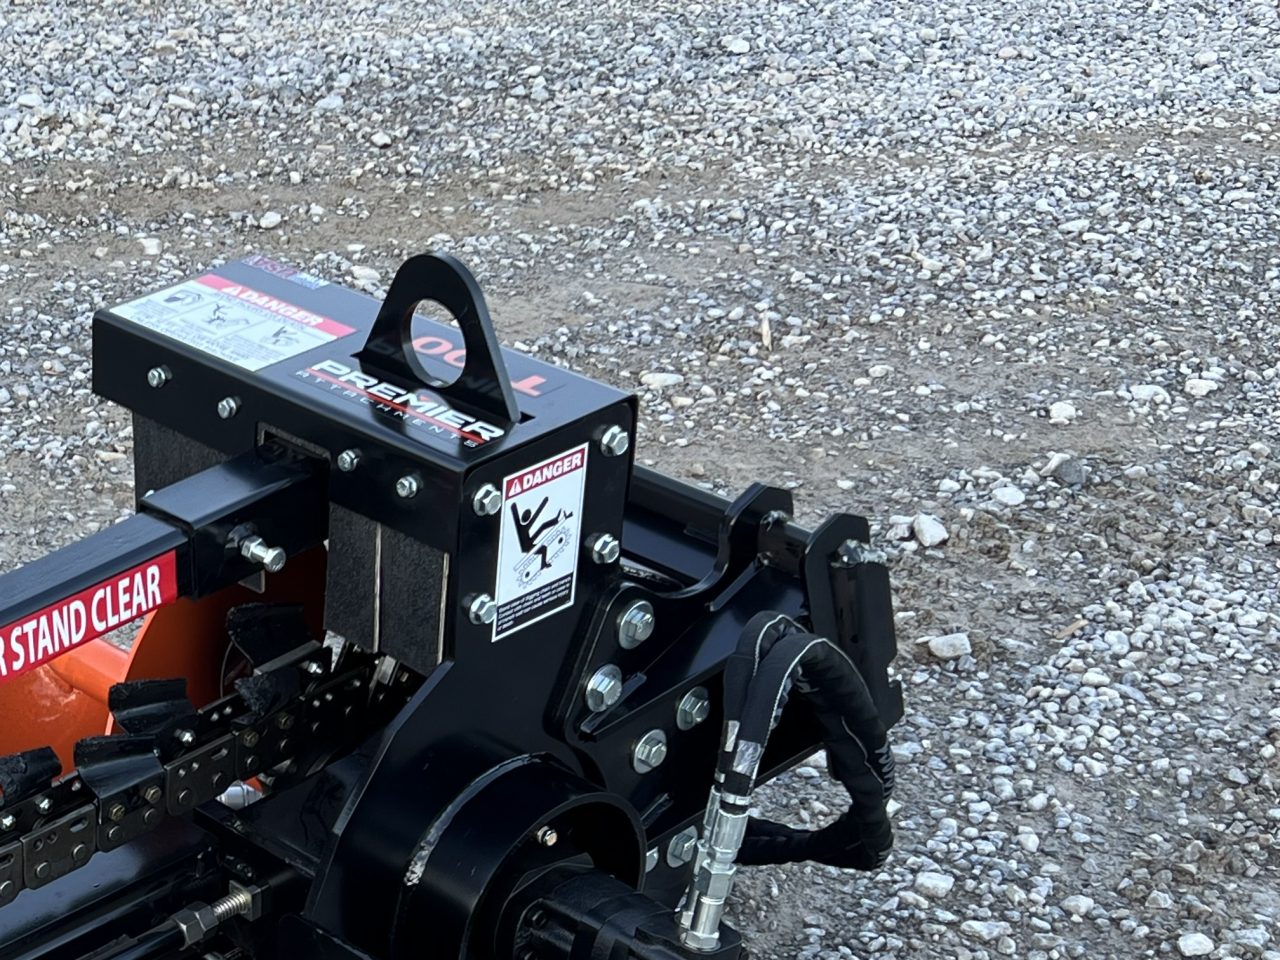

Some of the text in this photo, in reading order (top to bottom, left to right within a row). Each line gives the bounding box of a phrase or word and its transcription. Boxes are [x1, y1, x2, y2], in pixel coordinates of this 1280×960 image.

[238, 290, 324, 325] DANGER
[296, 370, 478, 448] ATTACHMENTS
[312, 359, 505, 442] PREMIER
[523, 453, 582, 490] DANGER
[10, 599, 87, 672] STAND
[91, 564, 162, 633] CLEAR
